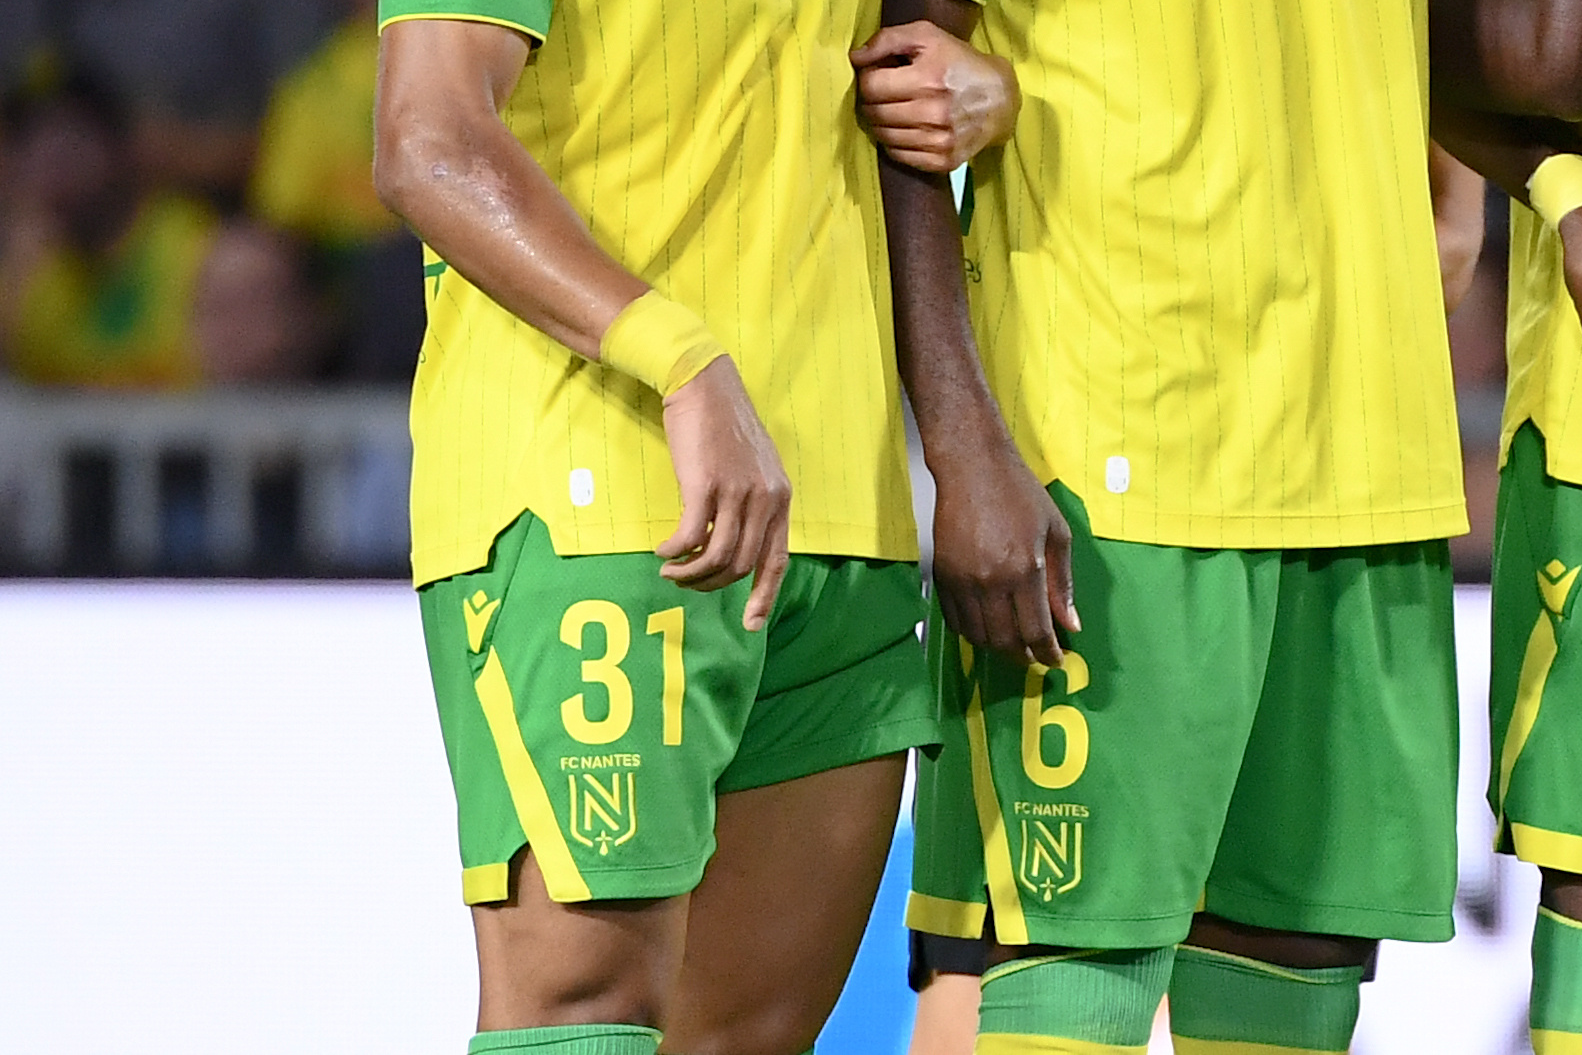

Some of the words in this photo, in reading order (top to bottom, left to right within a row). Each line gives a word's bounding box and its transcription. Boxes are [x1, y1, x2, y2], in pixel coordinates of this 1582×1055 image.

[559, 599, 685, 746] 31
[1022, 649, 1090, 790] 6
[560, 756, 580, 771] FC
[580, 753, 641, 769] NANTES
[1014, 801, 1031, 815] FC
[1033, 803, 1089, 818] NANTES
